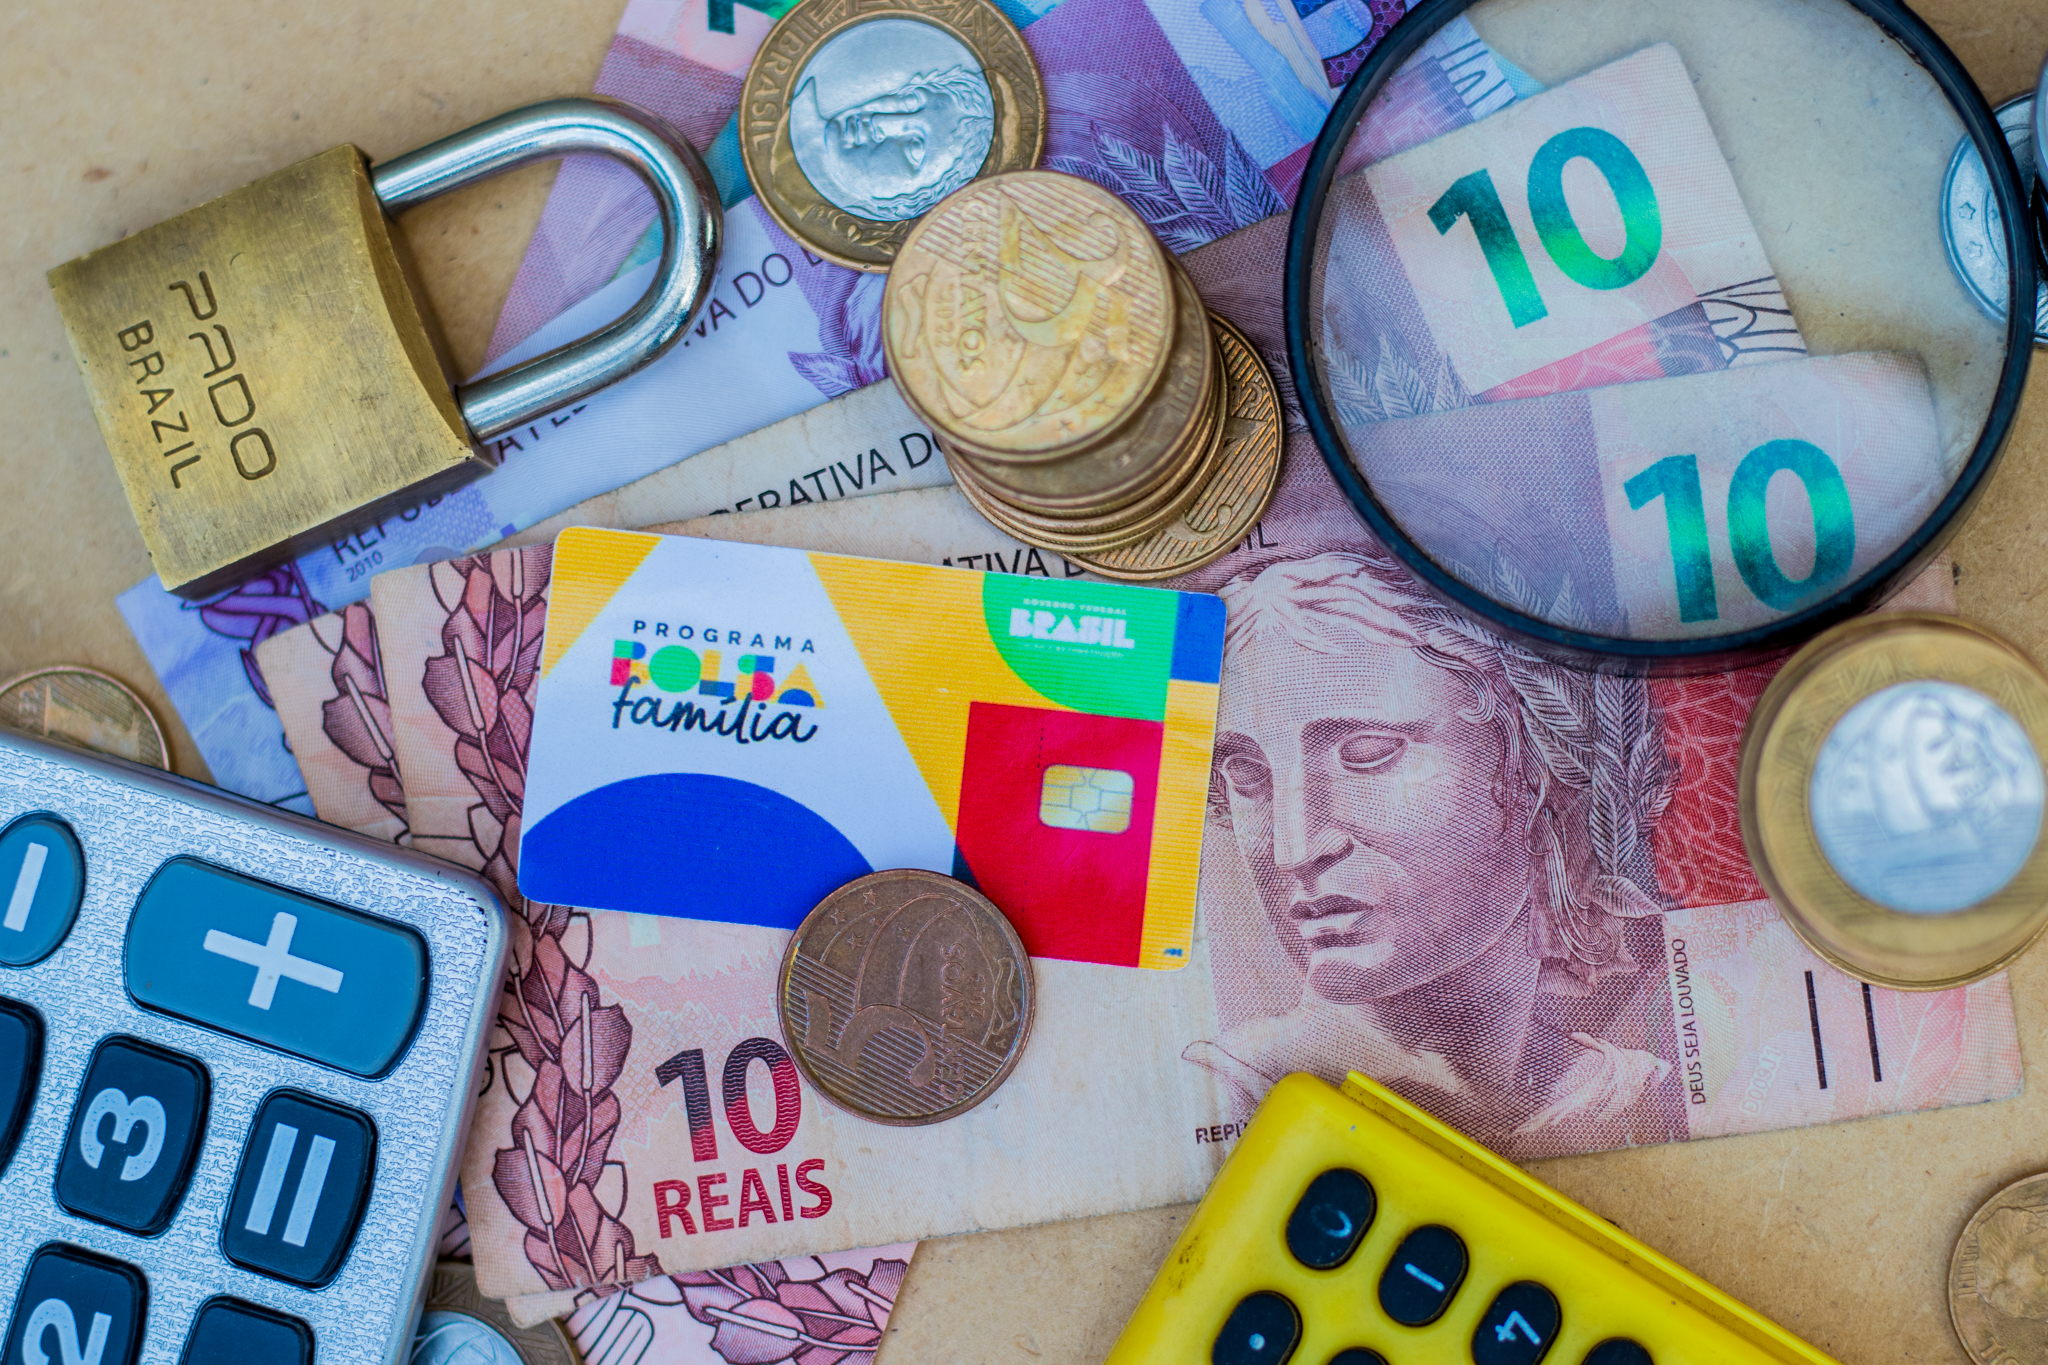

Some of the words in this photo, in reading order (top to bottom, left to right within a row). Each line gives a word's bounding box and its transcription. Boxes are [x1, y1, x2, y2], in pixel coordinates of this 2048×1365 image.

[1426, 126, 1663, 329] 10
[732, 252, 793, 309] DO
[117, 318, 202, 489] BRAZIL
[168, 270, 277, 481] PADO
[899, 431, 944, 470] D
[345, 550, 384, 583] 2010
[1622, 437, 1857, 623] 10
[632, 619, 815, 654] PROGRAMA
[1008, 607, 1136, 650] BRASIL
[610, 638, 826, 710] BOLSA
[611, 675, 819, 745] família
[1671, 938, 1695, 1017] LOUVADO
[939, 942, 966, 1101] CENTAVOS
[1682, 1020, 1700, 1058] SEJA
[654, 1037, 802, 1163] 10
[1687, 1061, 1706, 1105] DEUS
[80, 1087, 167, 1182] 3
[653, 1158, 833, 1239] REAIS
